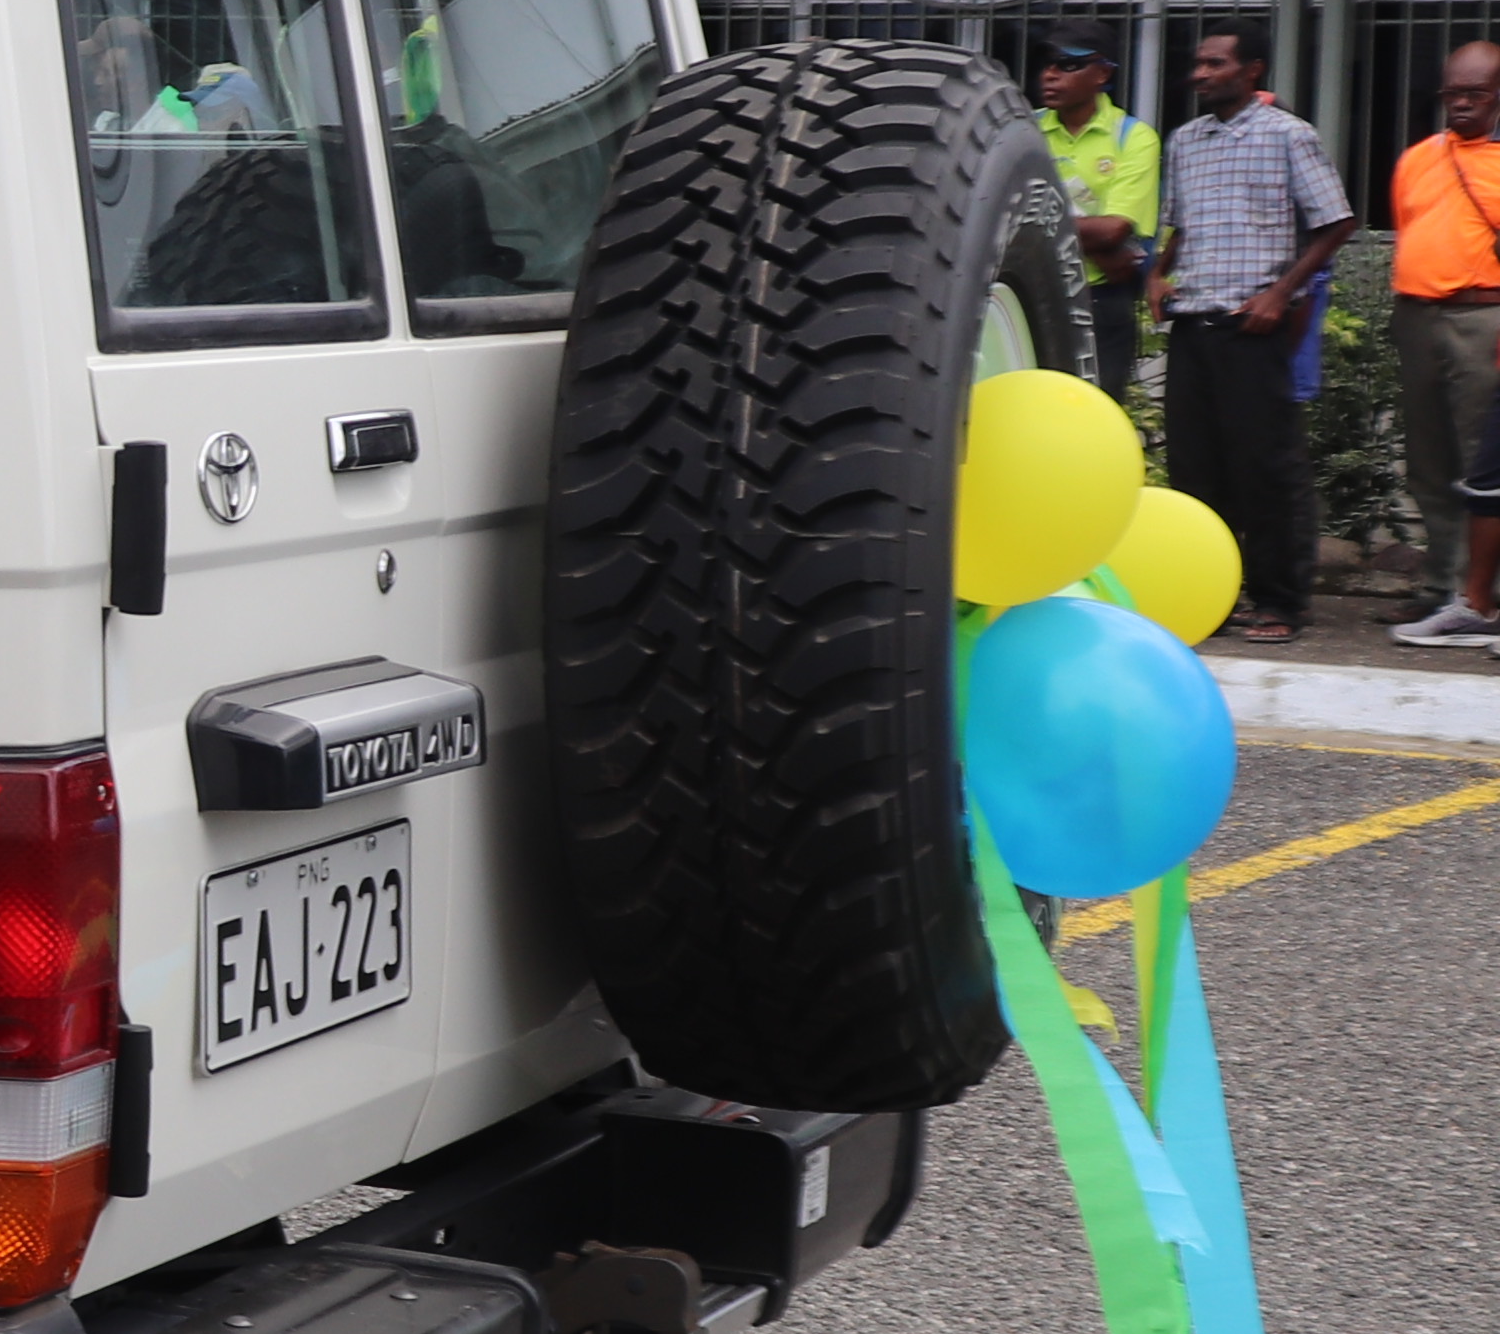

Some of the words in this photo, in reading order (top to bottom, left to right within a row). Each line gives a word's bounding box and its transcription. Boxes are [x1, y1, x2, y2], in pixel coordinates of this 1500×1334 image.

[326, 730, 417, 788] TOYOTA
[422, 715, 481, 768] 4WD
[297, 856, 330, 890] PNG
